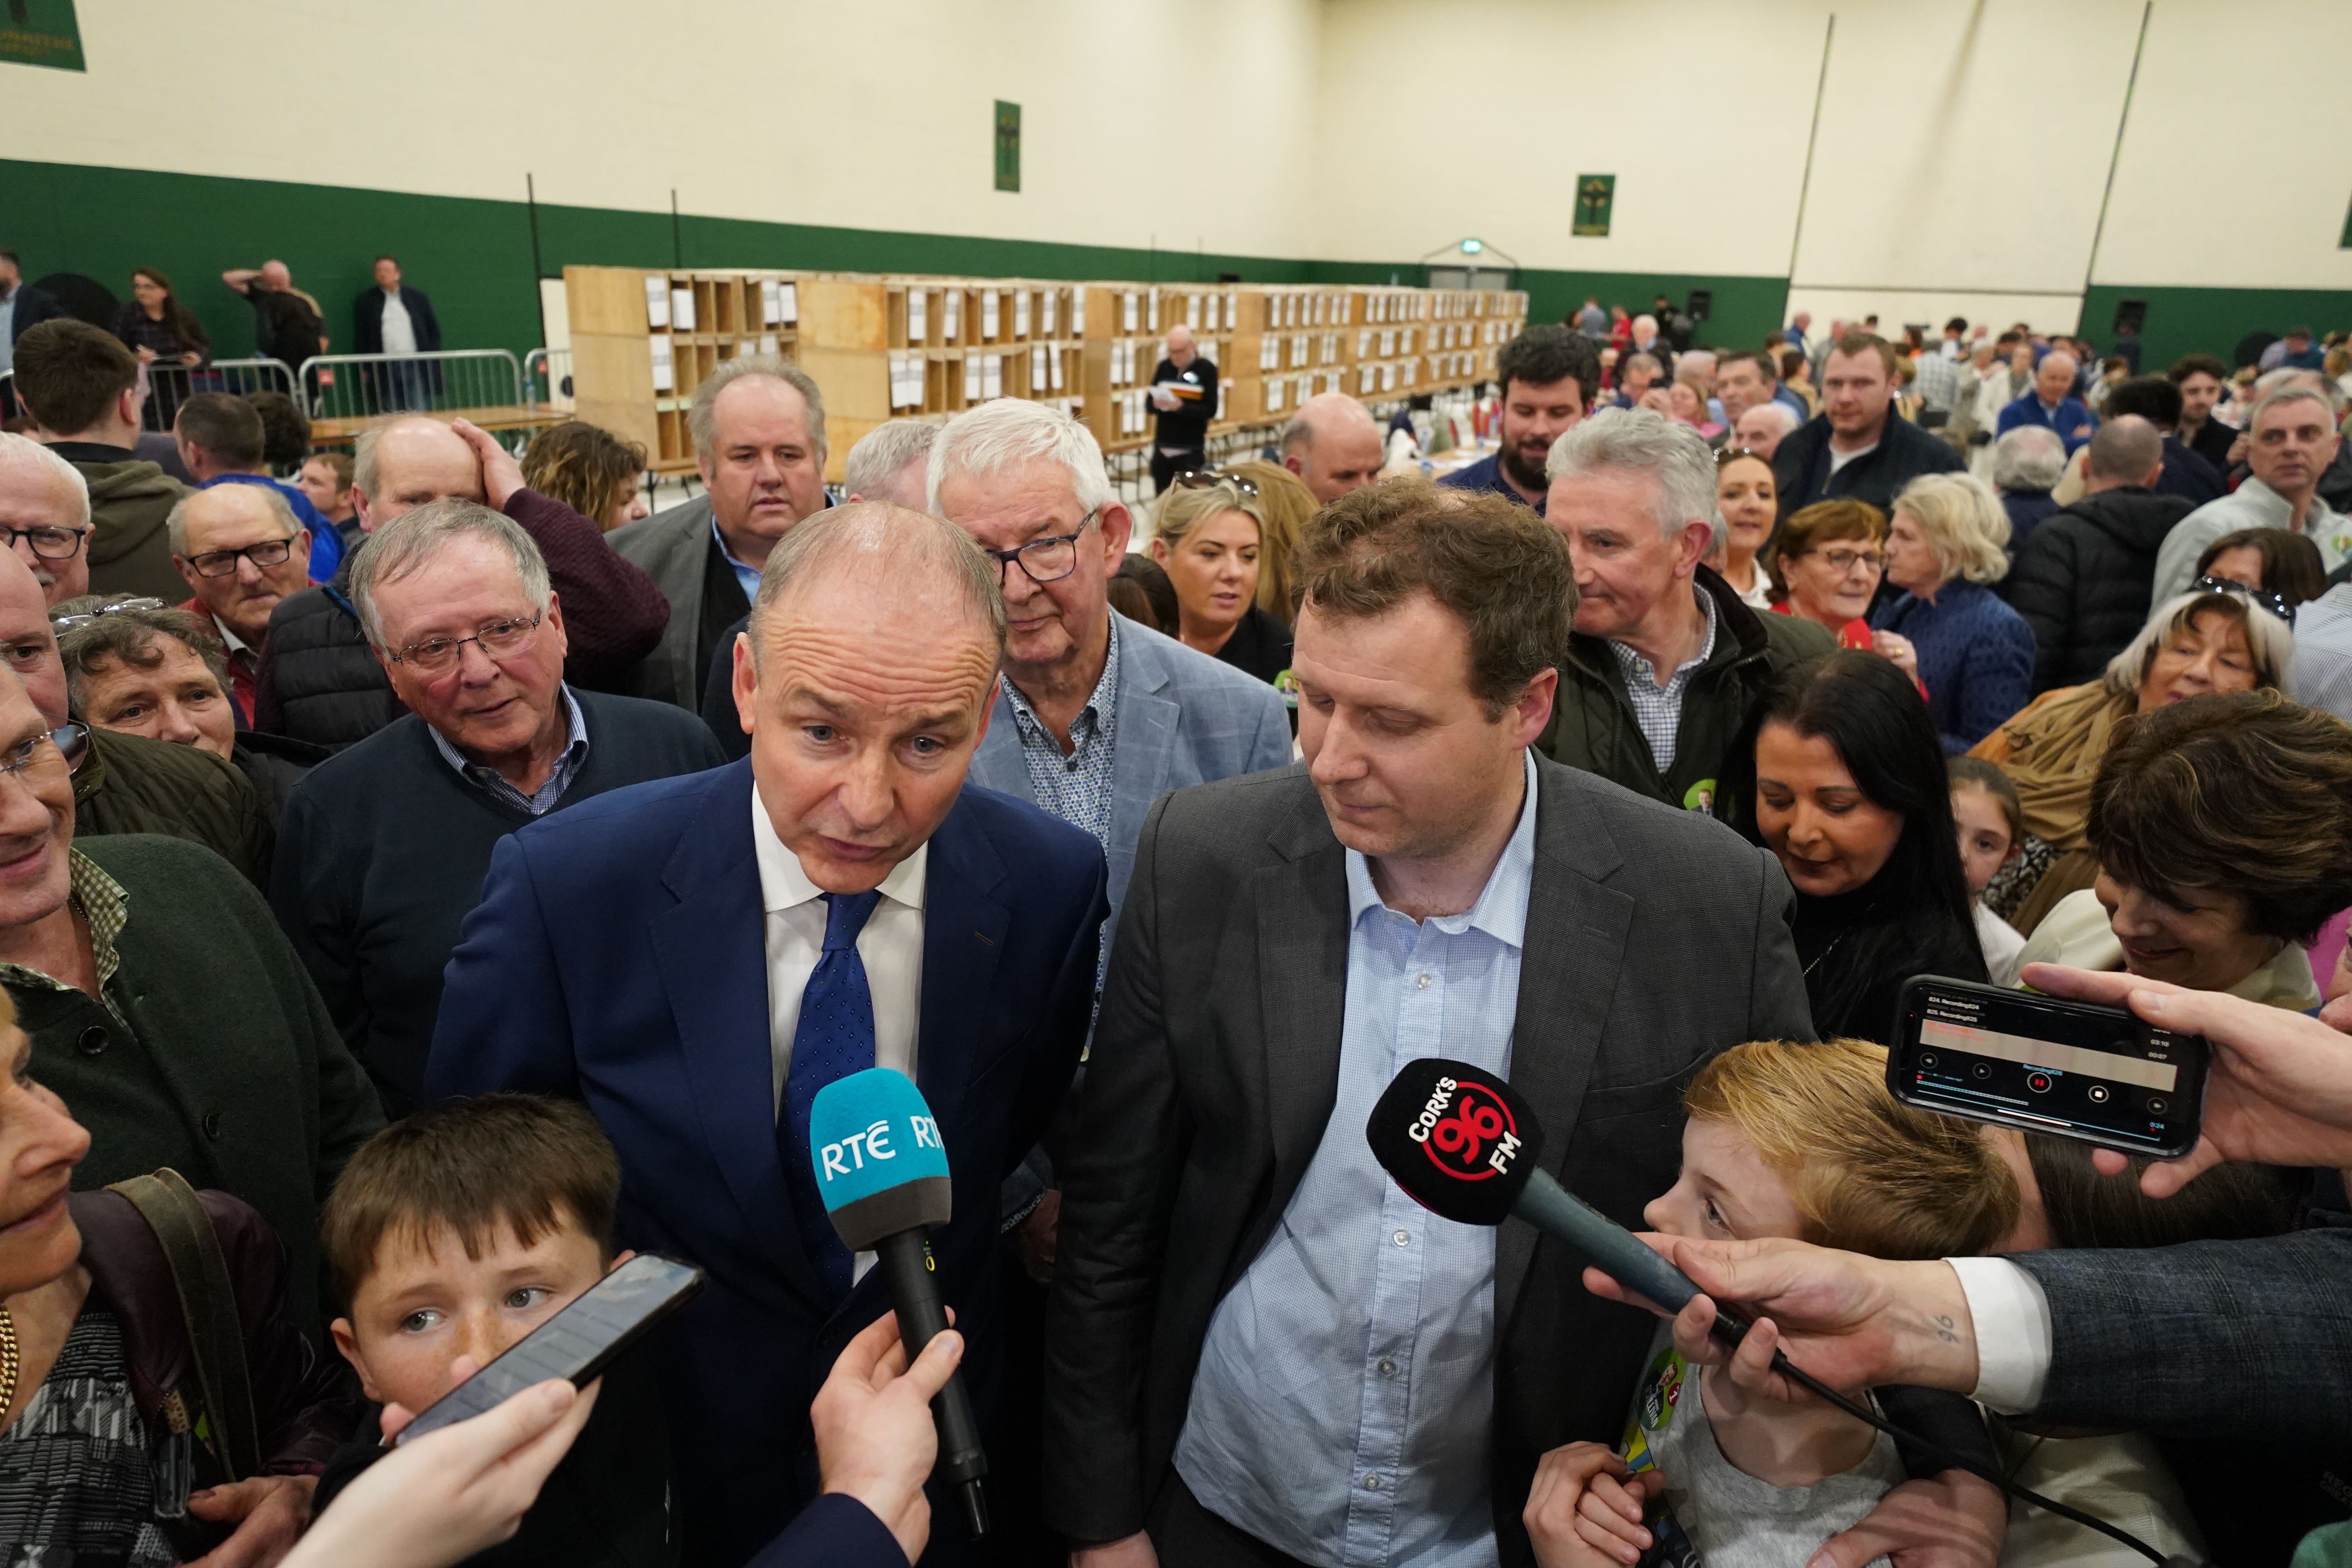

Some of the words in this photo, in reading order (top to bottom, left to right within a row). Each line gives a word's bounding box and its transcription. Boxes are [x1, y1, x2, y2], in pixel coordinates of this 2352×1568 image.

[1408, 1076, 1457, 1142] CORK'S
[1433, 1095, 1503, 1164] 96
[1488, 1131, 1521, 1175] FM
